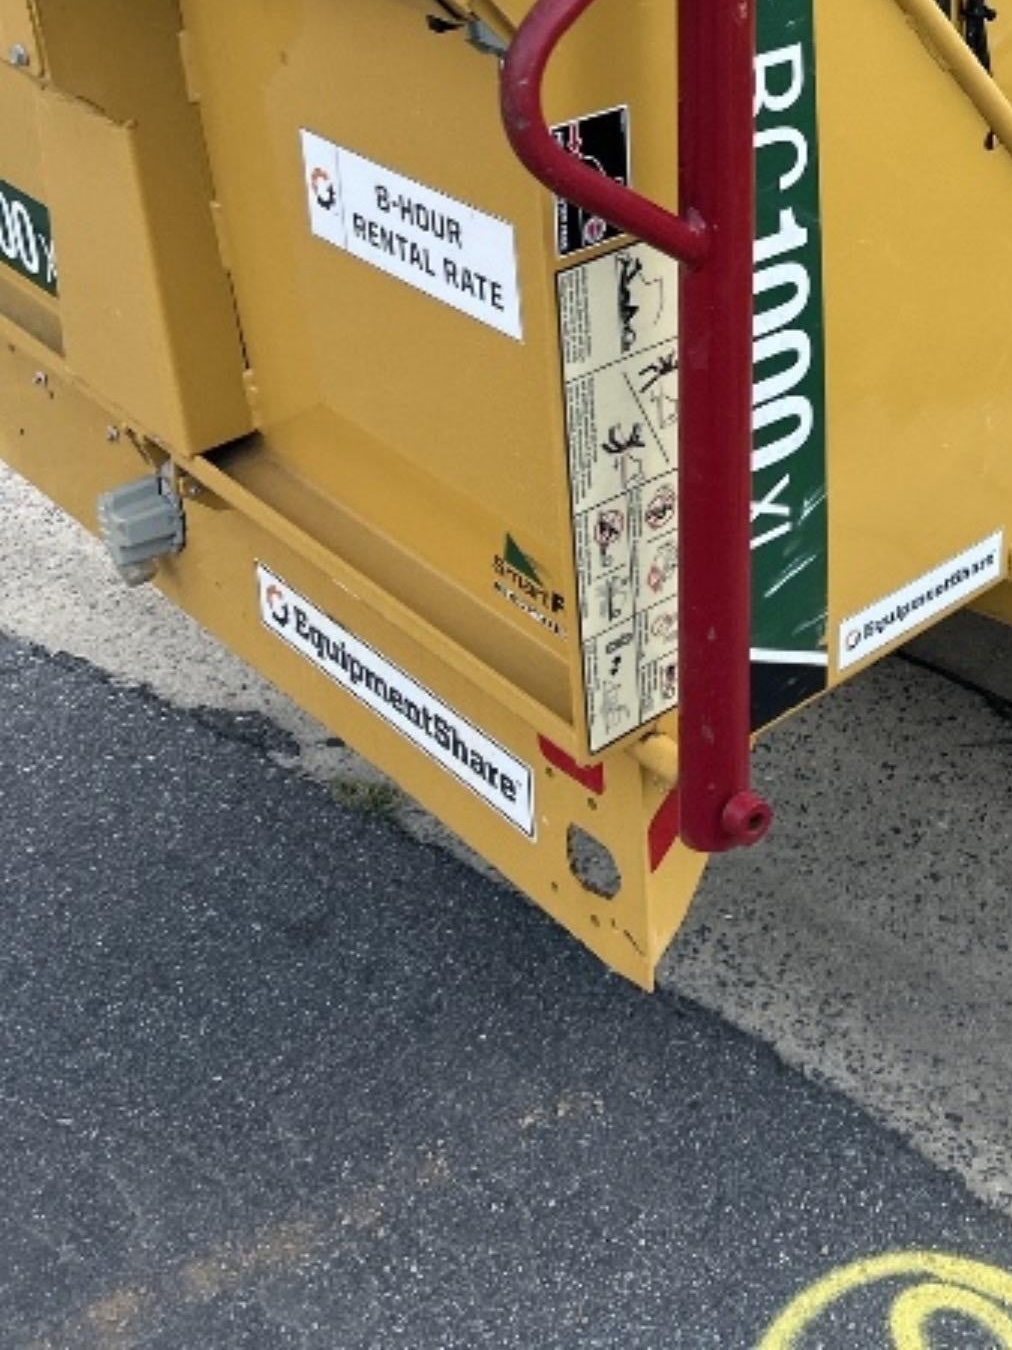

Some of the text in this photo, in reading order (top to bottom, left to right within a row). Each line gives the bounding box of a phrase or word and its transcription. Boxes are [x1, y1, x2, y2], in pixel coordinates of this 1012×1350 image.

[352, 212, 505, 312] RENTAL RATE
[293, 604, 518, 804] EquipmentShare
